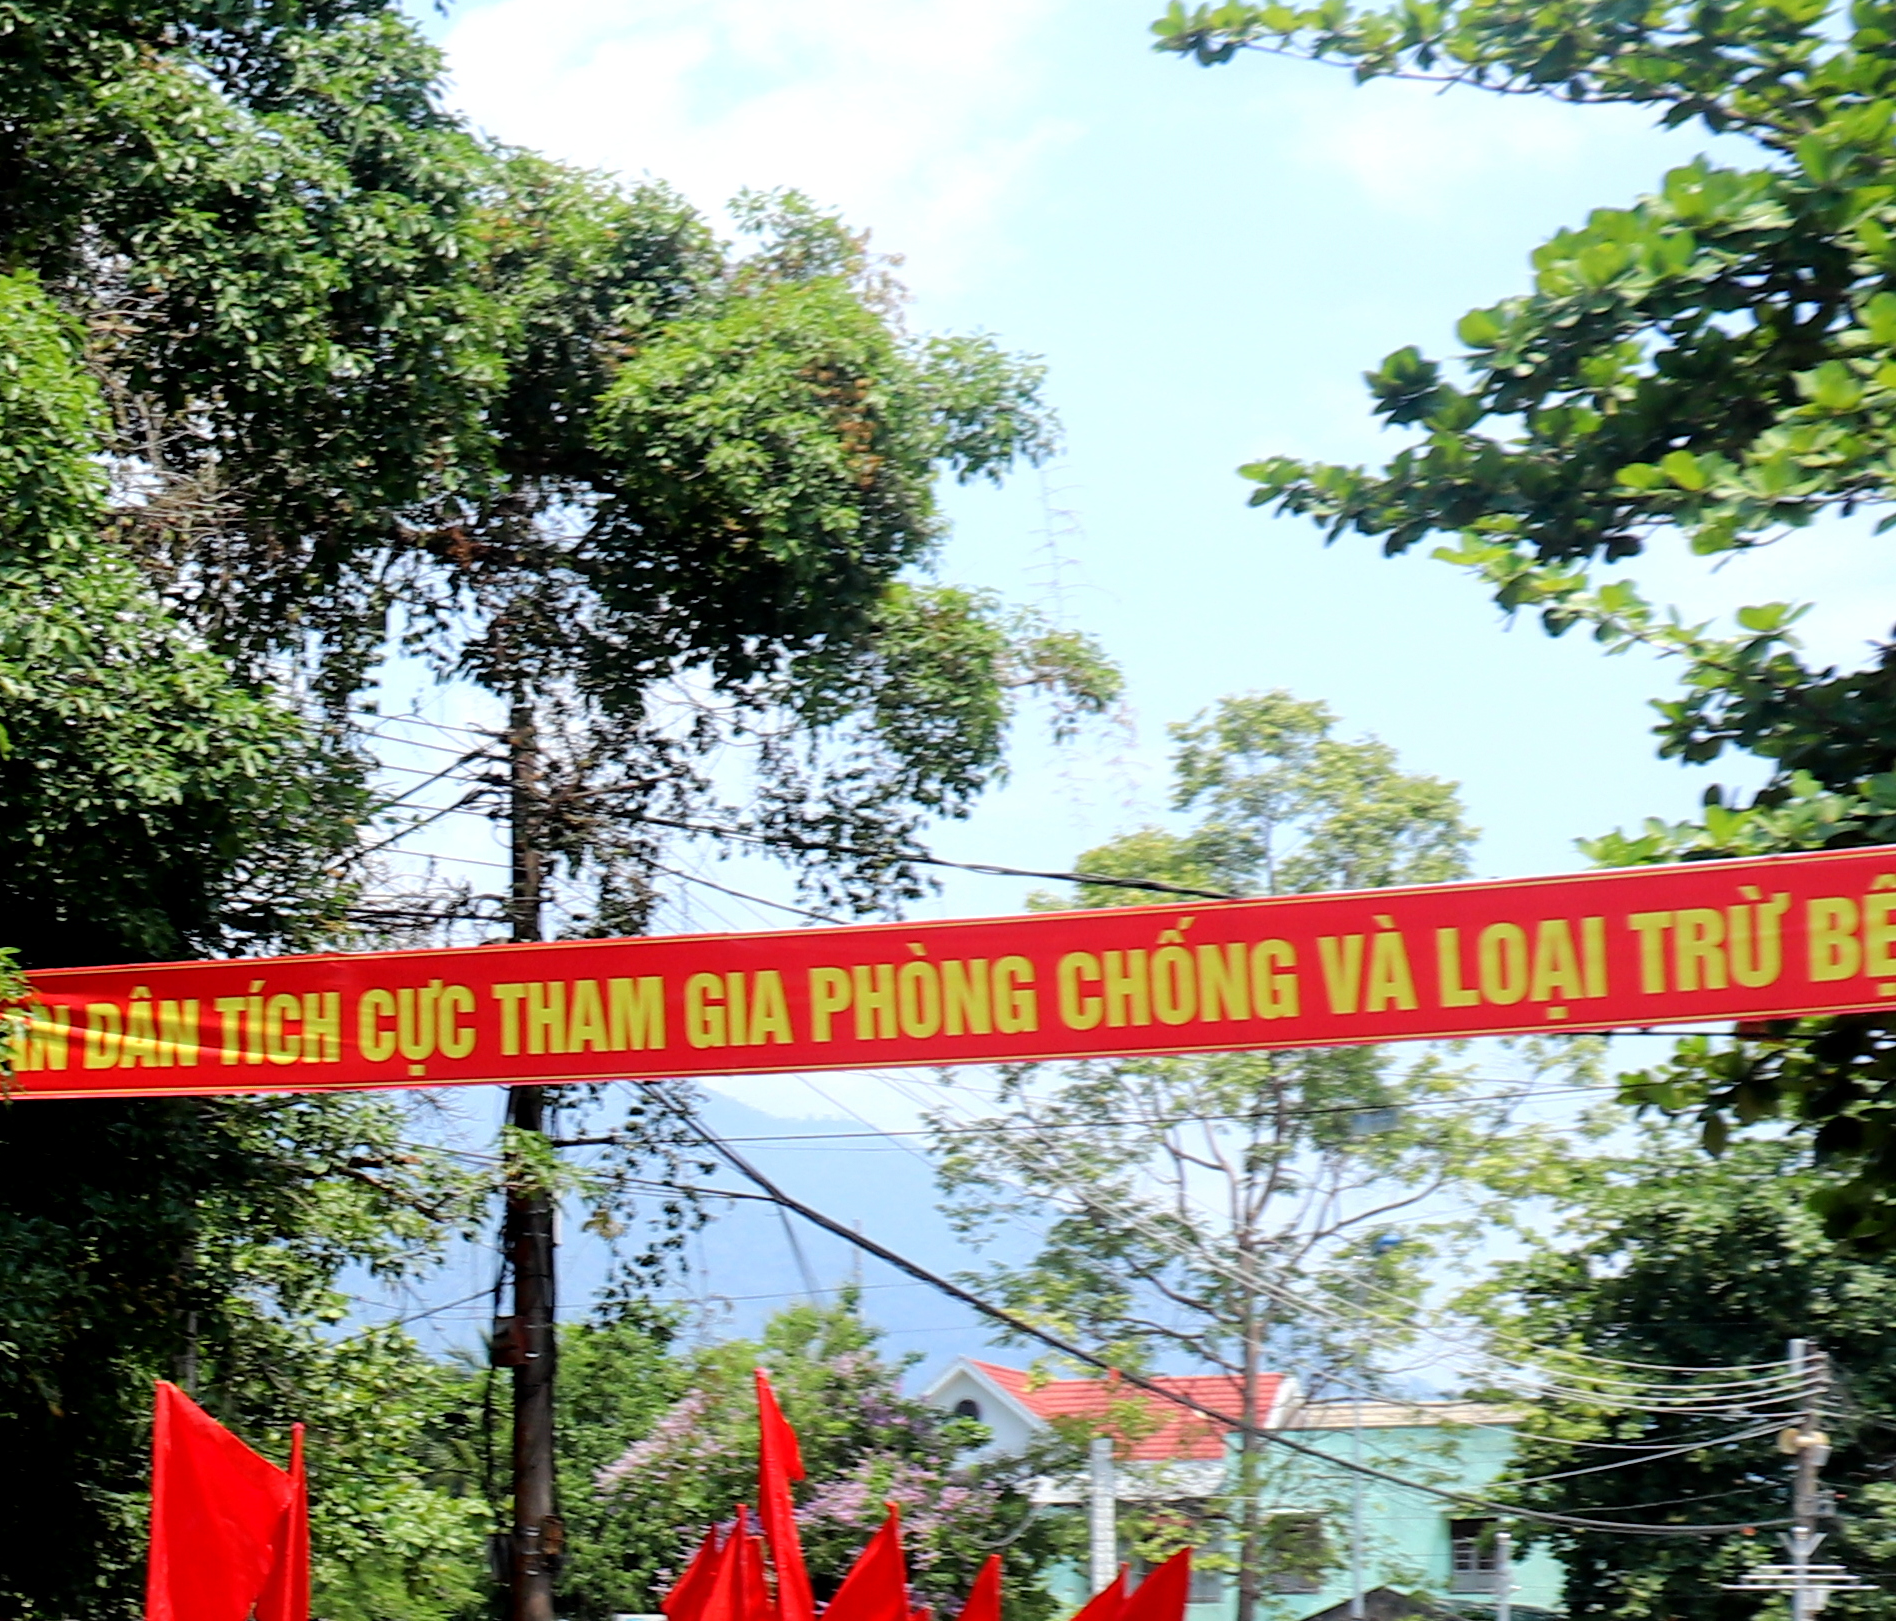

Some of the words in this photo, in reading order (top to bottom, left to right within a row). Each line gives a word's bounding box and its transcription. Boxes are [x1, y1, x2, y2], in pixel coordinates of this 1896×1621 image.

[82, 985, 200, 1070] DÂN
[213, 979, 342, 1067] TÍCH
[356, 978, 477, 1078] CỰC
[491, 975, 667, 1056] THAM
[683, 969, 795, 1049] GIA
[808, 941, 1040, 1043] PHÒNG
[1055, 916, 1301, 1031] CHỐNG
[1316, 913, 1420, 1015] VÀ
[1436, 915, 1608, 1020] LOẠI
[1627, 885, 1792, 995] TRỪ
